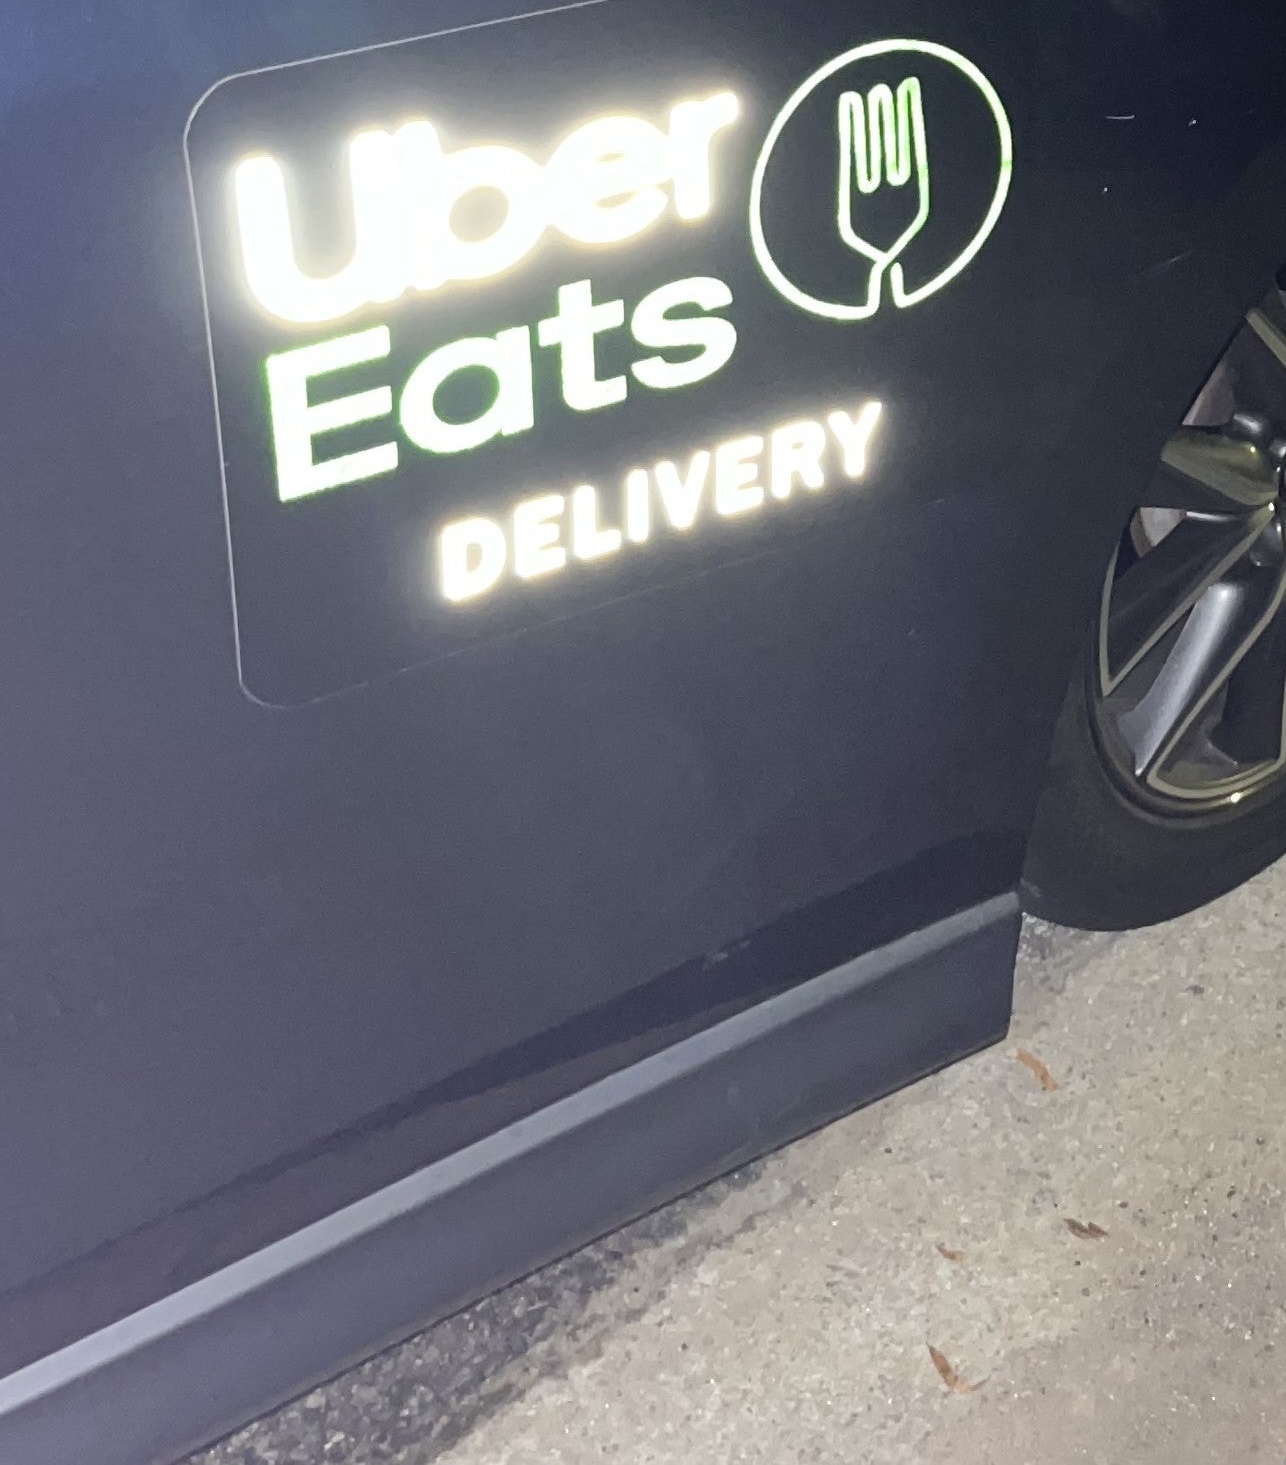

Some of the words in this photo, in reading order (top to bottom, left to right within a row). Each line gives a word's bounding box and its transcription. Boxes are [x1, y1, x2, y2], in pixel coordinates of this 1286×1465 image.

[234, 90, 741, 325] Uber
[264, 275, 738, 502] Eats
[437, 400, 885, 603] DELIVERY
